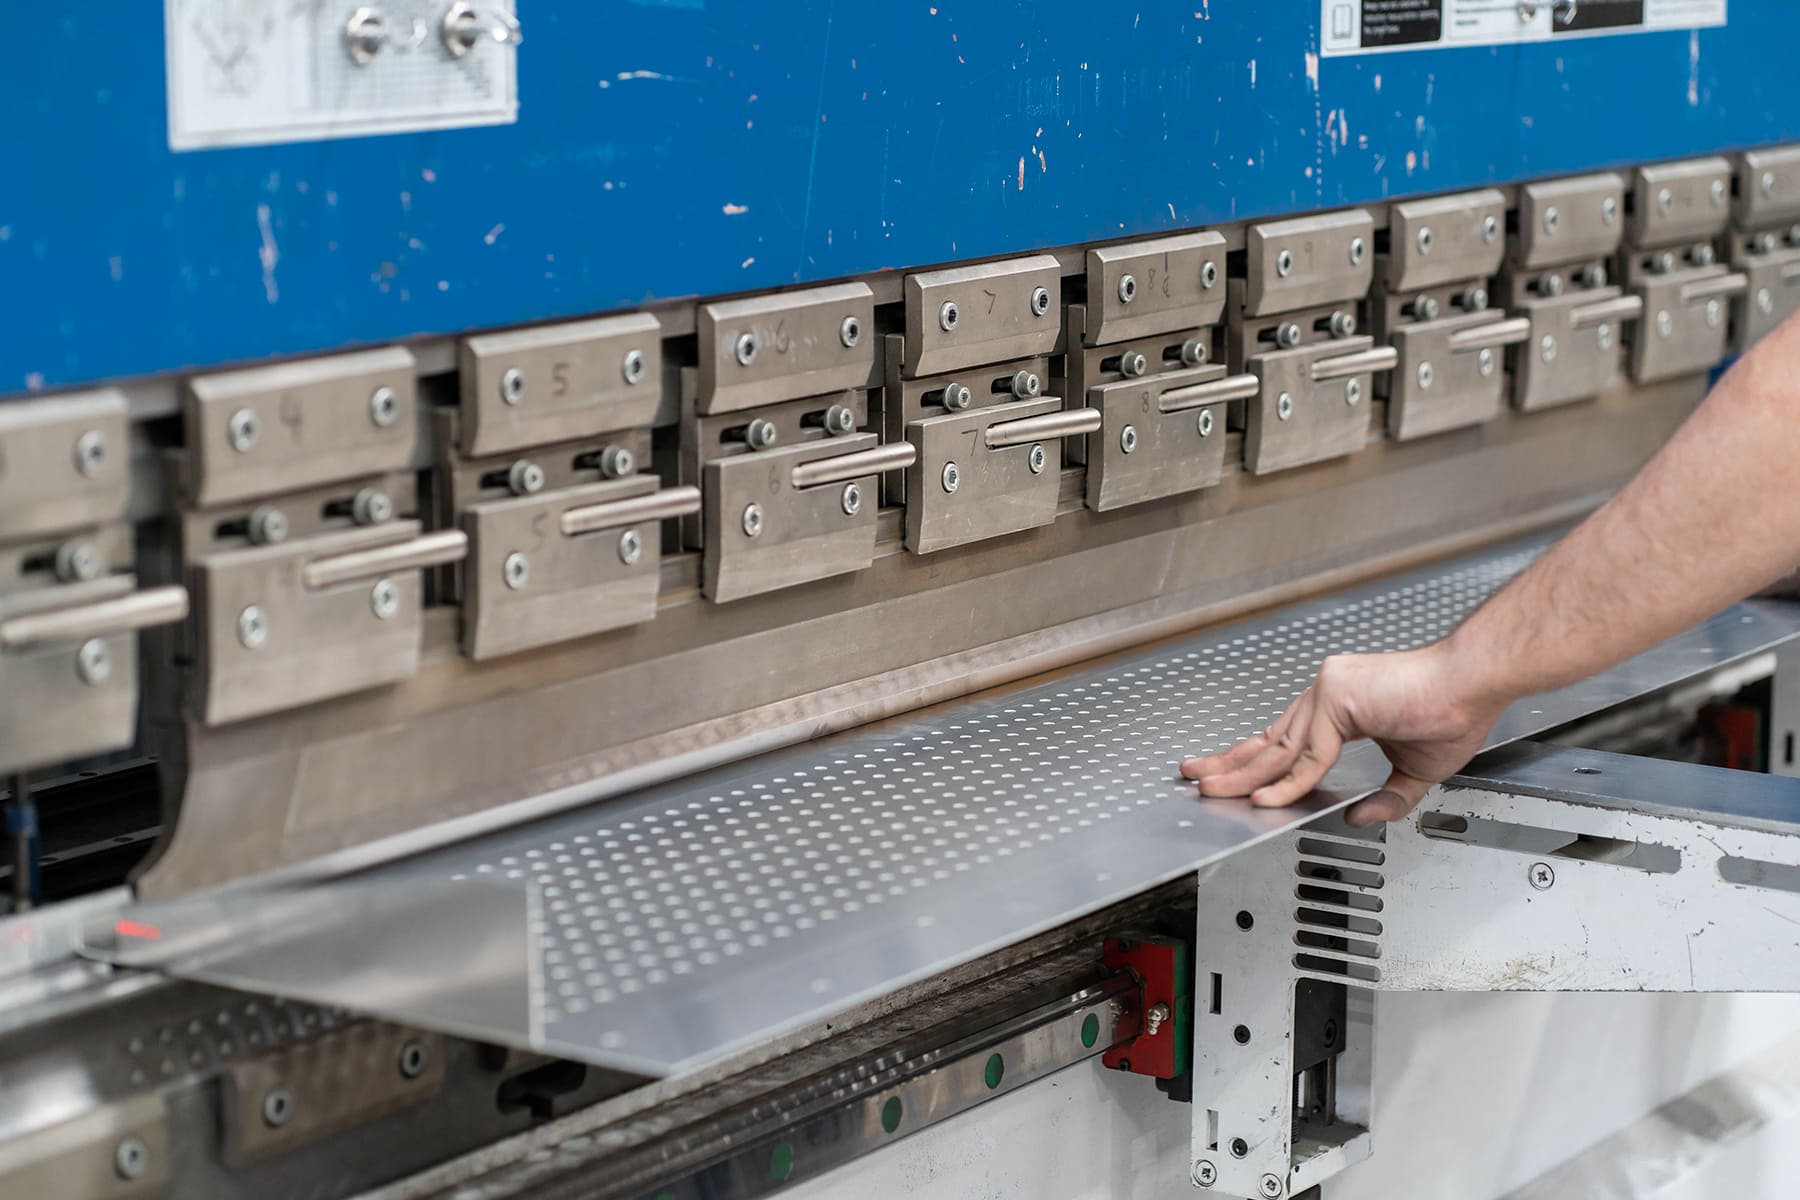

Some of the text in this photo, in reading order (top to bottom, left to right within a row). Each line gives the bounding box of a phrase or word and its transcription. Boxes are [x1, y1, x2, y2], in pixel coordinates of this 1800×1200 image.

[983, 289, 996, 315] 7
[775, 319, 790, 354] 6
[552, 361, 570, 397] 5
[279, 392, 303, 444] 4
[1142, 391, 1149, 413] 8
[961, 428, 978, 456] 7
[768, 464, 780, 495] 6
[530, 511, 549, 552] 5
